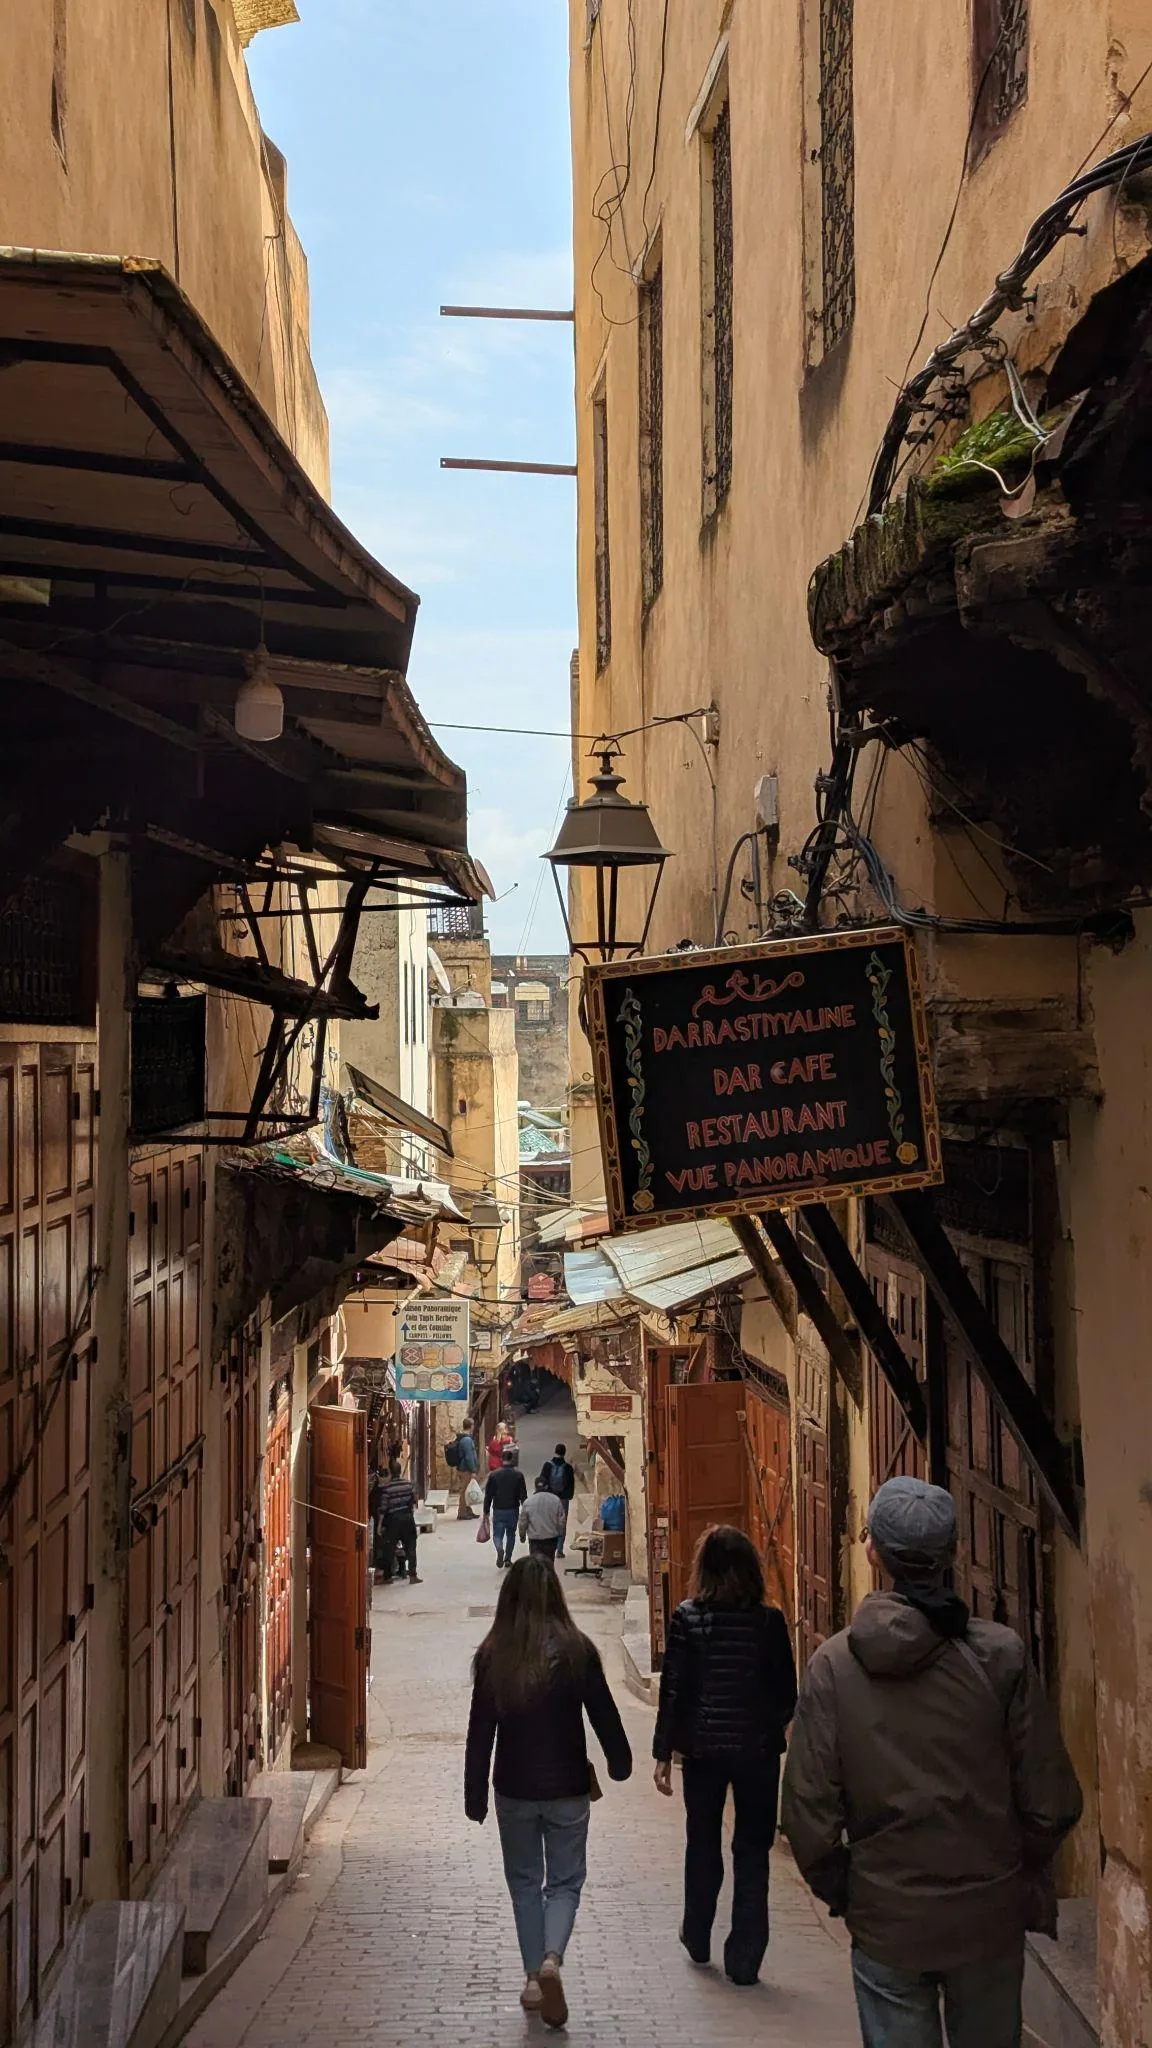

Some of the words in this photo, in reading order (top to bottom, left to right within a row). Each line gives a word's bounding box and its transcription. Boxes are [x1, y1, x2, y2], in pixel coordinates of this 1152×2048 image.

[692, 969, 805, 1018] مطعم
[713, 1063, 763, 1096] DAR
[770, 1053, 836, 1084] CAFE
[686, 1101, 847, 1150] RESTAURANT
[665, 1164, 719, 1193] VUE
[724, 1140, 891, 1187] PANORAMIQUE
